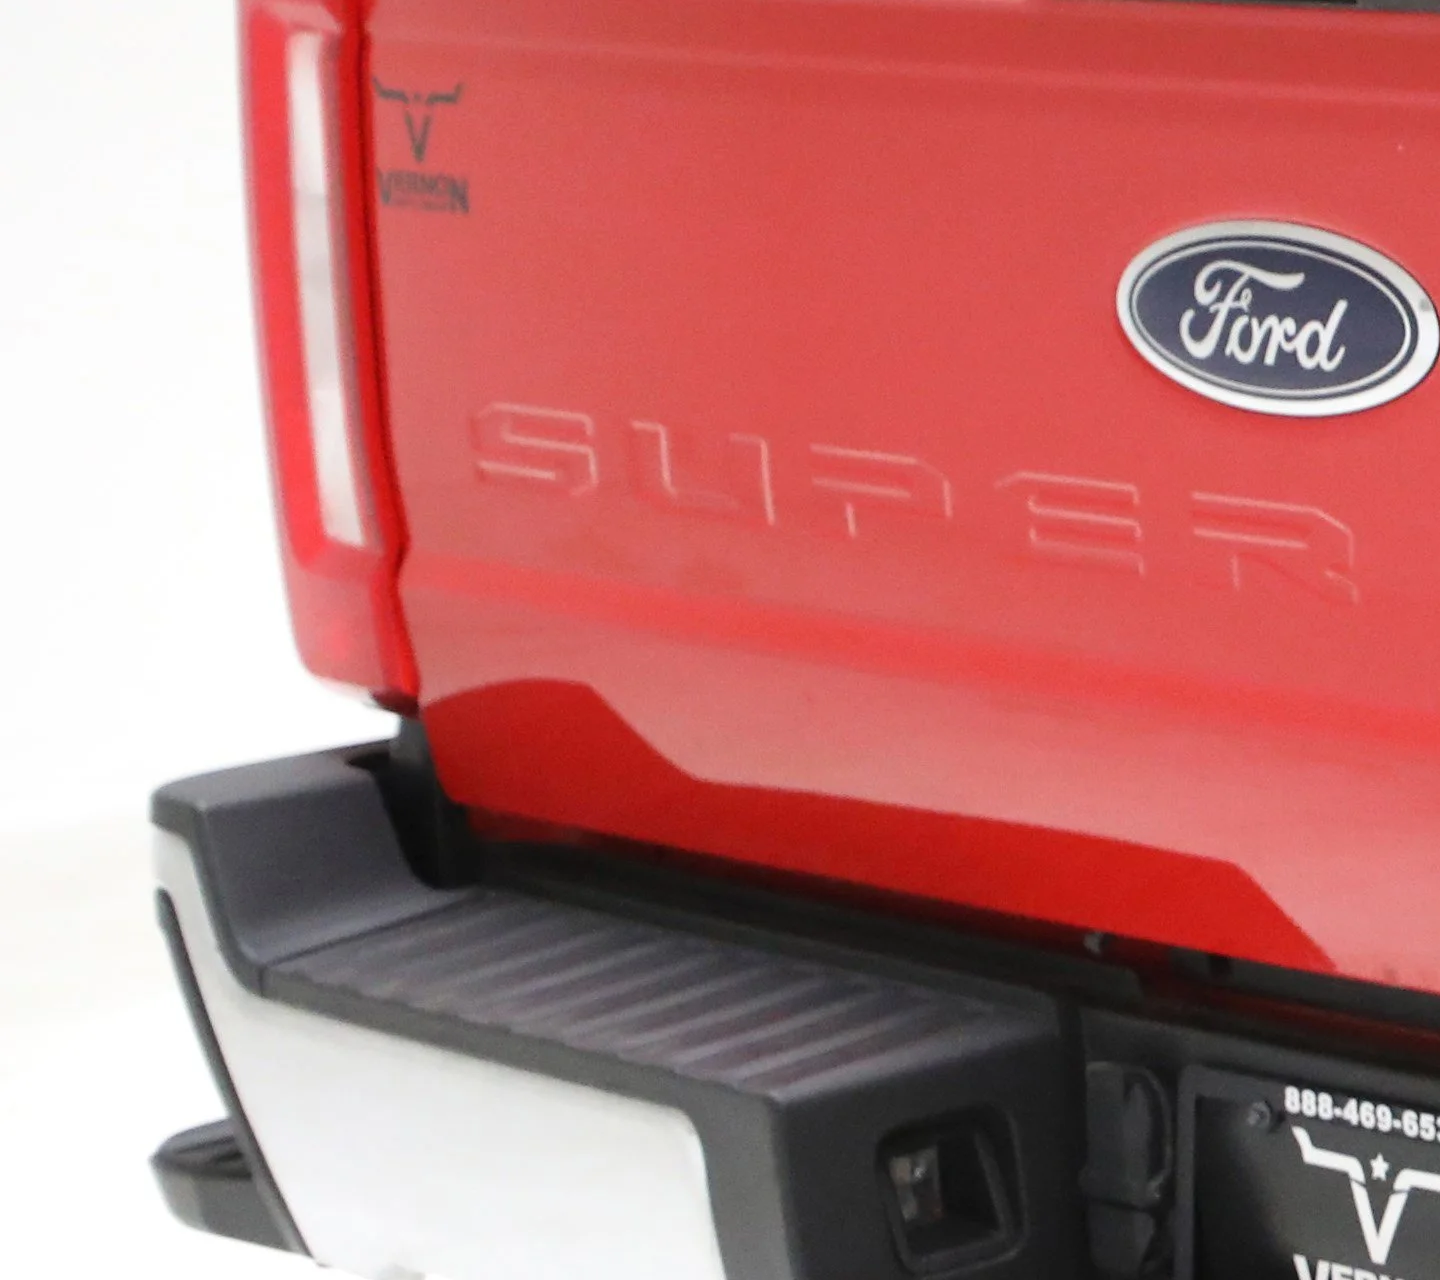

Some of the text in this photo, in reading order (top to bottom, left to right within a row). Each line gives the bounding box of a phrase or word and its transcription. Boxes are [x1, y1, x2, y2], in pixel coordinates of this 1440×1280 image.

[376, 167, 470, 214] VERNON
[1180, 259, 1349, 373] Ford
[470, 402, 1360, 605] SUPER
